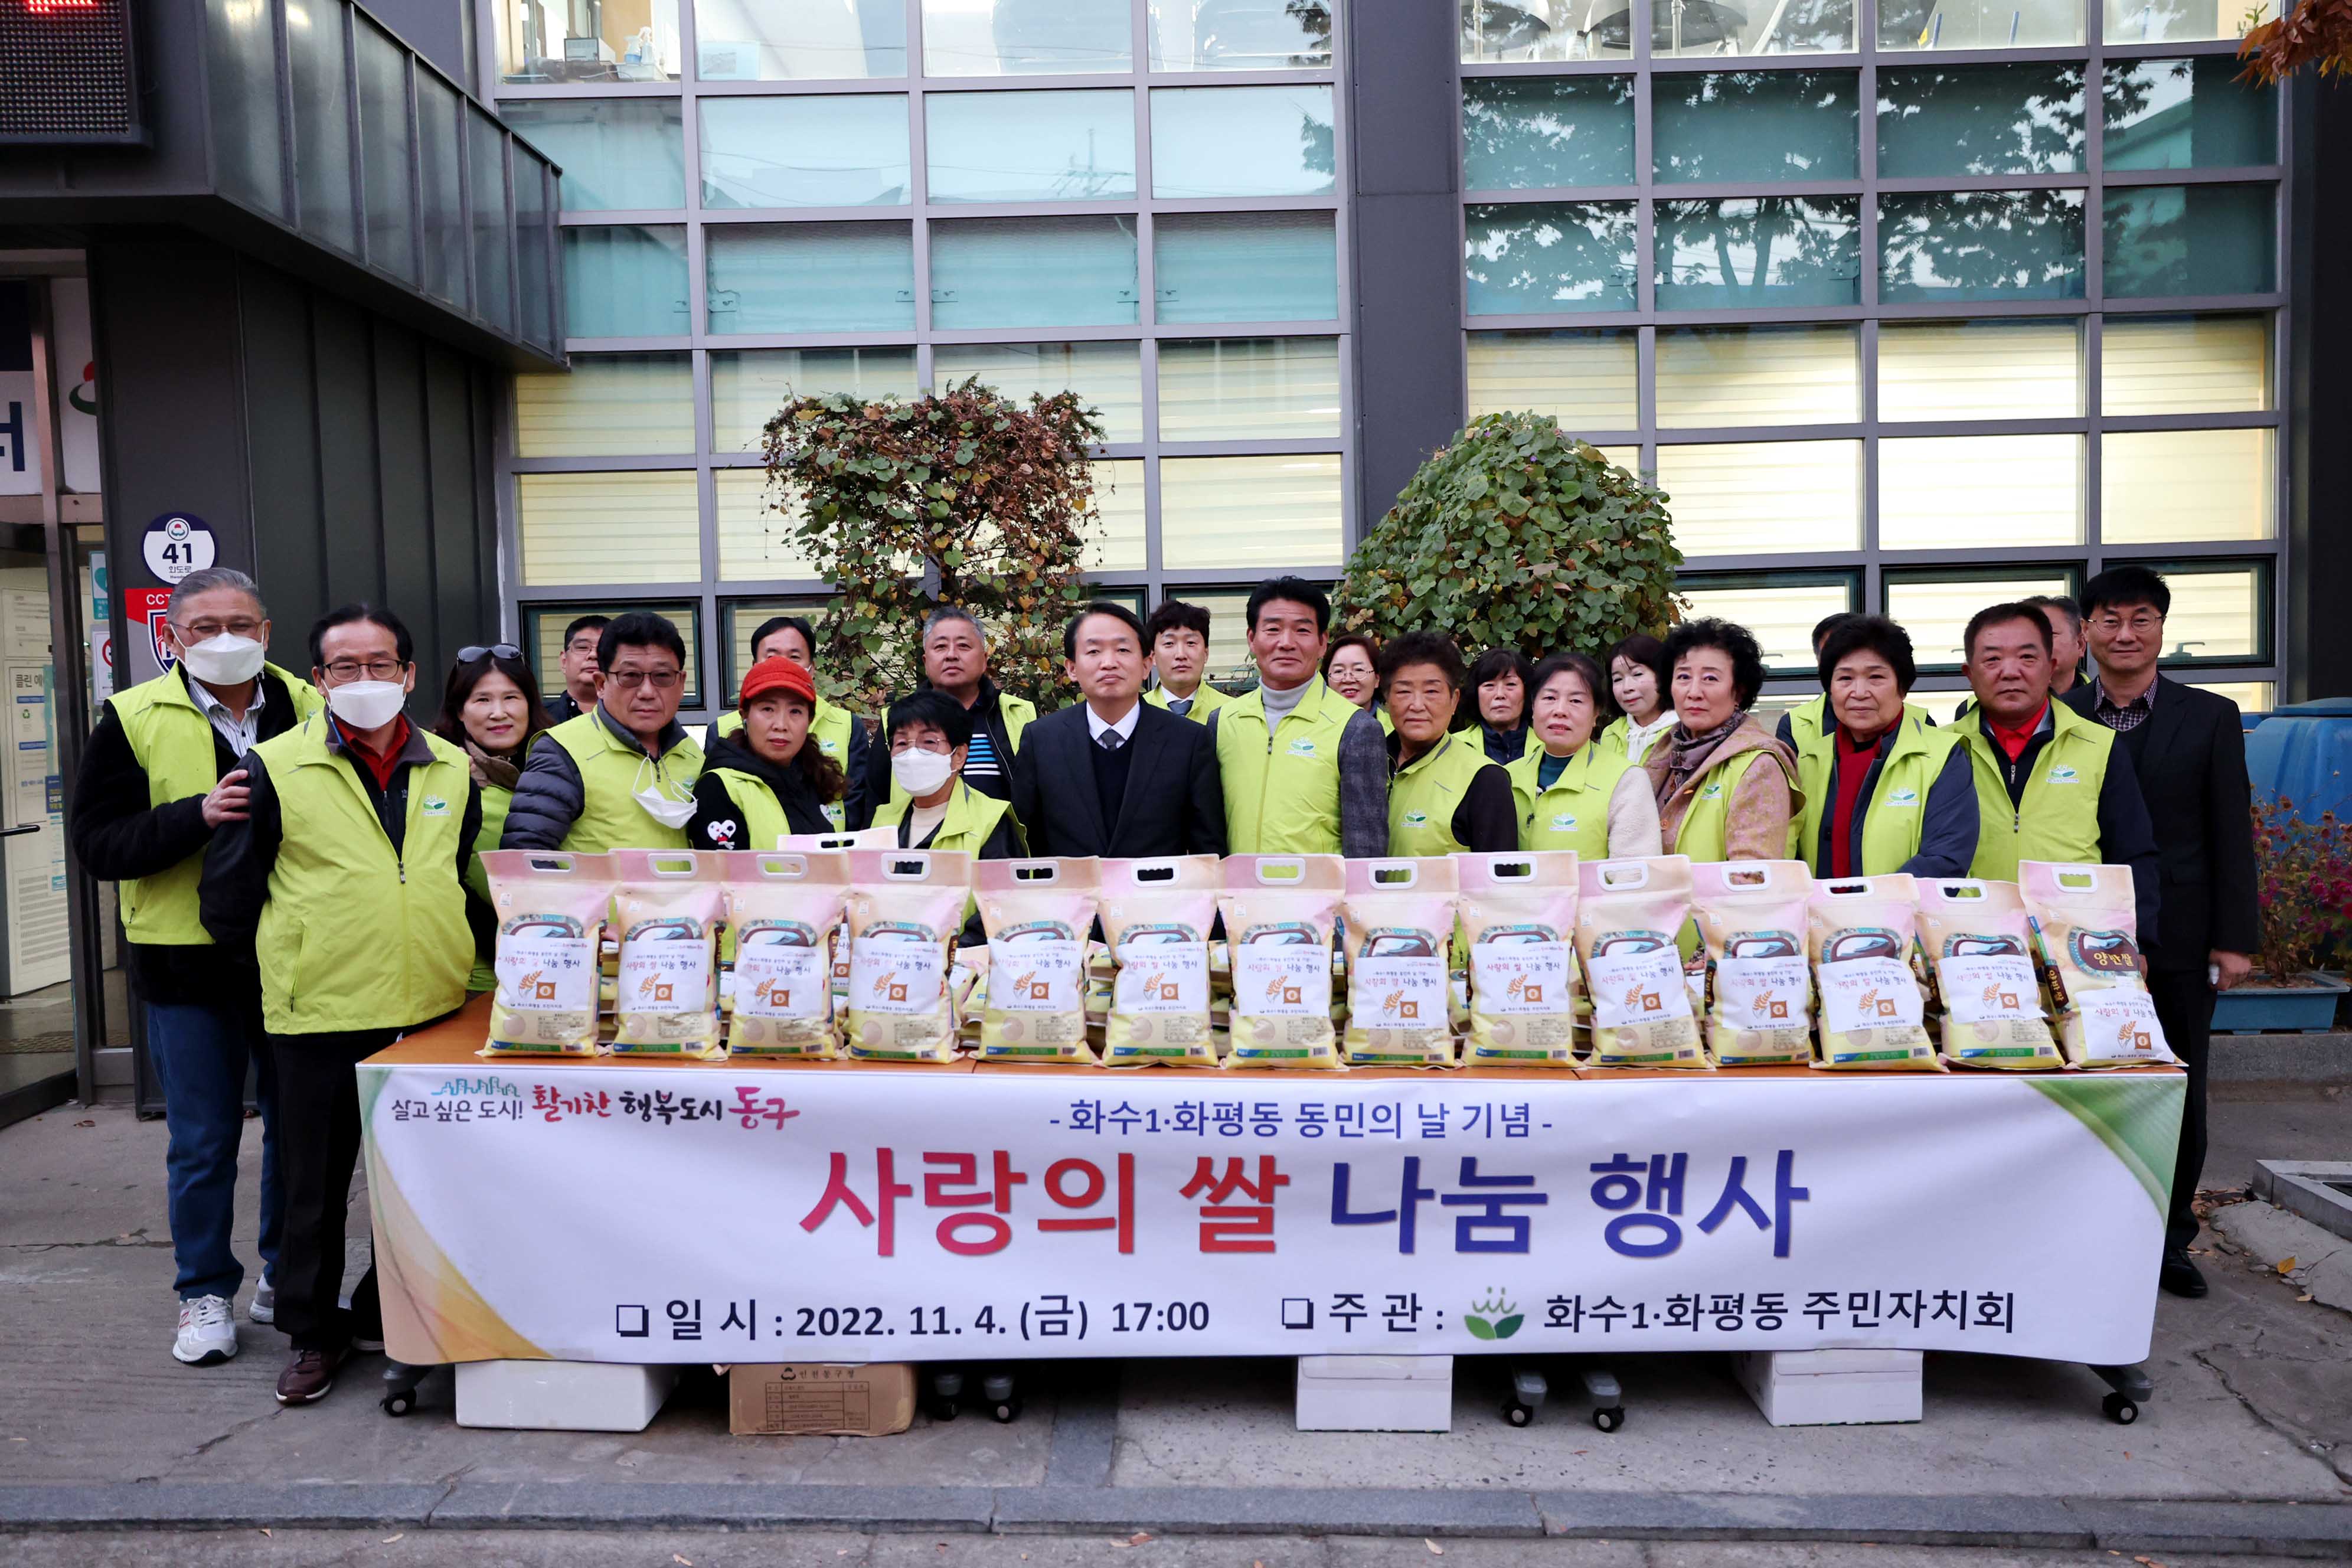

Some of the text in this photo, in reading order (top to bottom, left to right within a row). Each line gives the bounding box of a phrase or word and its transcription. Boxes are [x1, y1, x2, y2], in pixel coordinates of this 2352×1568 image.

[162, 543, 192, 564] 41
[563, 959, 580, 969] 행사
[680, 961, 697, 970] 행사
[915, 961, 931, 971] 행사
[1055, 959, 1071, 968] 행사
[2093, 952, 2134, 967] 양반쌀
[392, 1084, 801, 1130] 살고 싶은 도시! 활기찬 행복도시 동구
[1296, 1103, 1401, 1139] 동민의
[1419, 1104, 1451, 1139] 날
[1463, 1103, 1530, 1139] 기념
[800, 1148, 1810, 1259] 사랑의 쌀 나눔 행사
[797, 1308, 895, 1337] 2022.
[911, 1307, 962, 1335] 11.
[975, 1306, 1006, 1334] 4.
[1021, 1296, 1088, 1341] (금)
[1113, 1302, 1210, 1332] 17:00
[1804, 1291, 2014, 1334] 주민자치회
